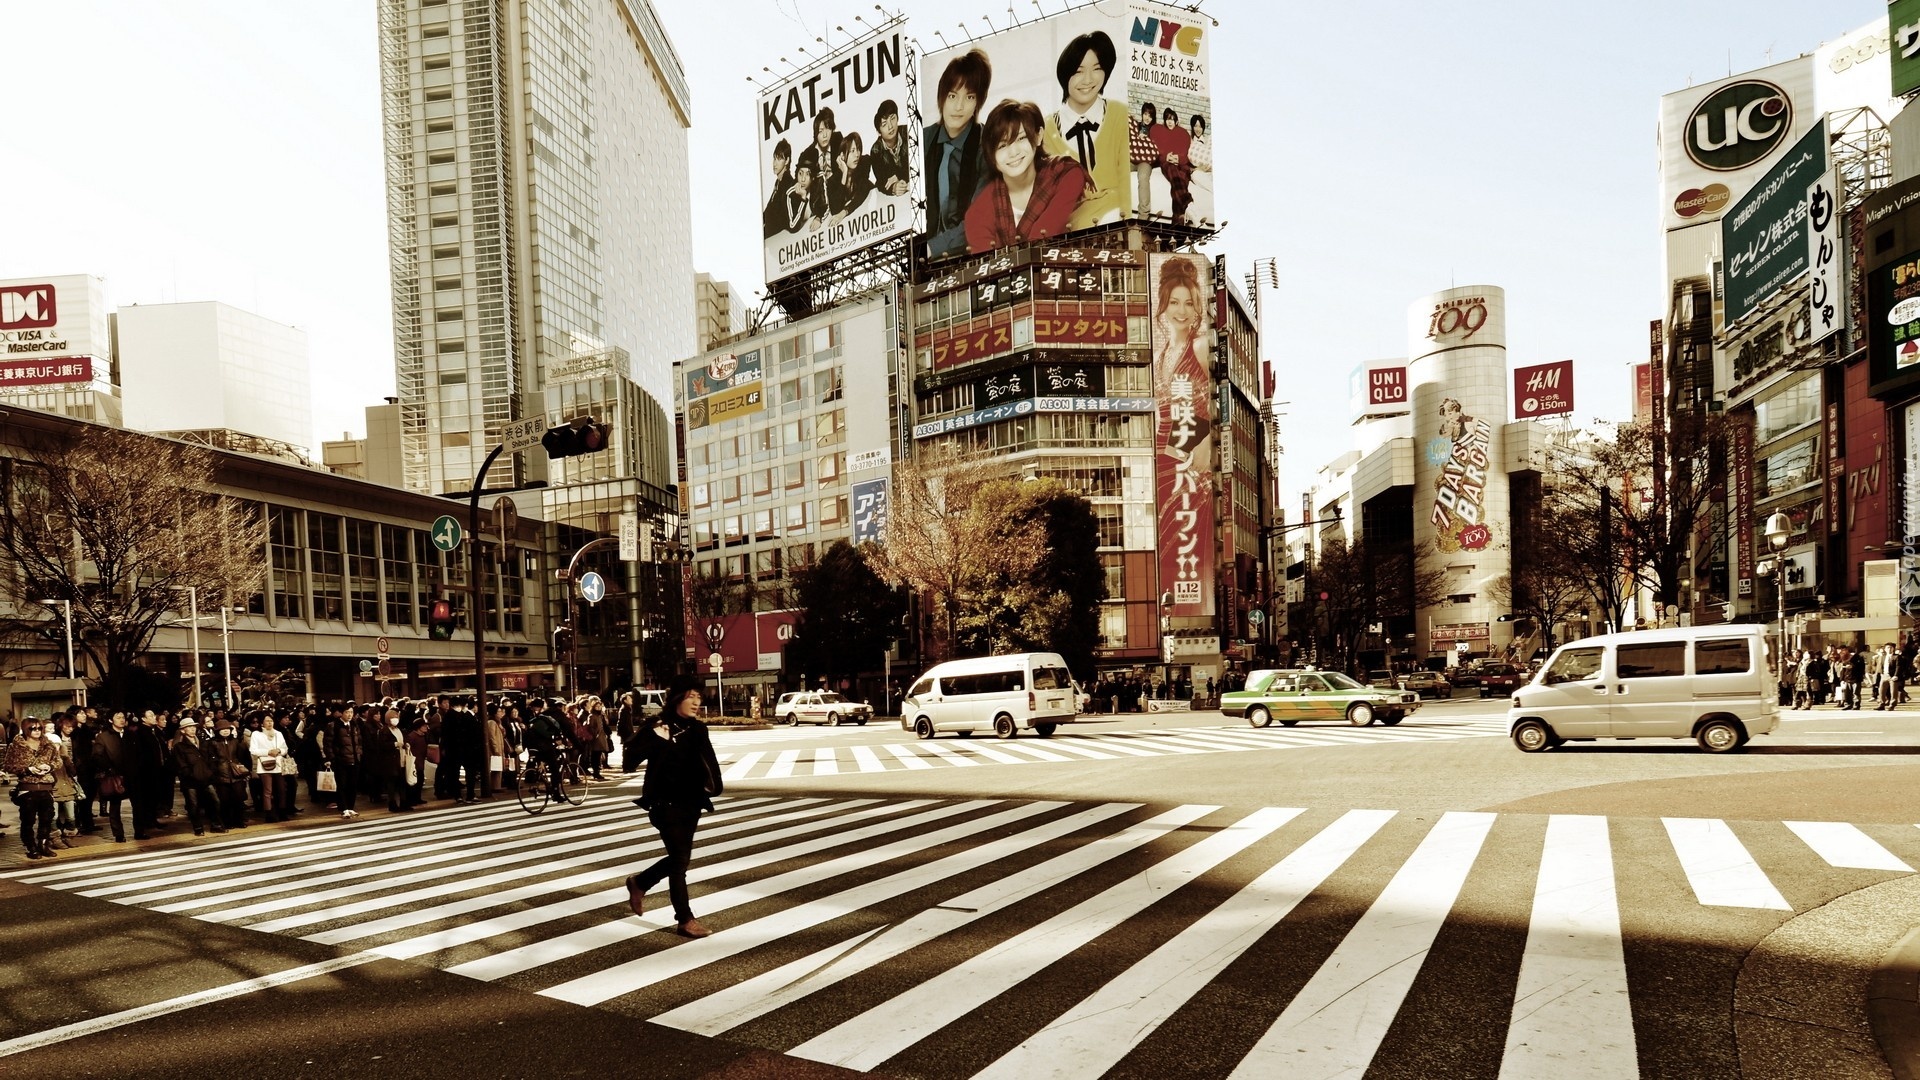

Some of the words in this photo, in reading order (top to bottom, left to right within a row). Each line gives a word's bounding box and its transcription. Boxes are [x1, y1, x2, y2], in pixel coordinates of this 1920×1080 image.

[1130, 16, 1203, 57] NYC
[1131, 48, 1203, 75] よく遊びよく学べ
[763, 33, 901, 141] KAT-TUN
[1132, 66, 1169, 86] 2010.10.20
[1170, 74, 1199, 92] RELEASE
[1675, 191, 1728, 210] MasterCard
[1866, 204, 1893, 225] Mighty
[778, 231, 825, 265] CHANGE
[828, 224, 845, 245] UR
[848, 204, 896, 237] WORLD
[871, 223, 896, 239] RELEASE
[1745, 253, 1771, 278] SEIREN
[1810, 183, 1834, 328] もんじゃ
[1743, 256, 1804, 307] http://www.seiren.com
[1, 289, 49, 323] DC
[1435, 297, 1485, 310] SHIBUYA
[1035, 319, 1124, 338] コンタクト
[1425, 303, 1487, 339] 109
[17, 330, 42, 341] VISA
[49, 330, 57, 338] &
[935, 327, 1010, 363] プライス
[8, 340, 67, 354] MasterCard
[1373, 371, 1400, 386] UNI
[1526, 367, 1562, 392] H&M
[748, 392, 759, 404] 4F
[1039, 399, 1071, 410] AEON
[1075, 398, 1152, 410] 英会話イーオン
[1373, 386, 1403, 402] QLO
[710, 395, 745, 416] プロミス
[1018, 402, 1029, 412] 6F
[1540, 400, 1567, 411] 150m
[944, 405, 1013, 431] 英会話イーオン
[505, 419, 544, 441] 渋谷駅前
[916, 421, 941, 437] AEON
[512, 438, 530, 449] Shibuya
[850, 457, 887, 472] 03-3770-1195
[1456, 419, 1491, 527] BARGAIN
[1432, 505, 1450, 529] 7
[627, 520, 635, 557] 渋谷駅前
[1465, 529, 1487, 545] 109
[1177, 583, 1198, 593] 1.12
